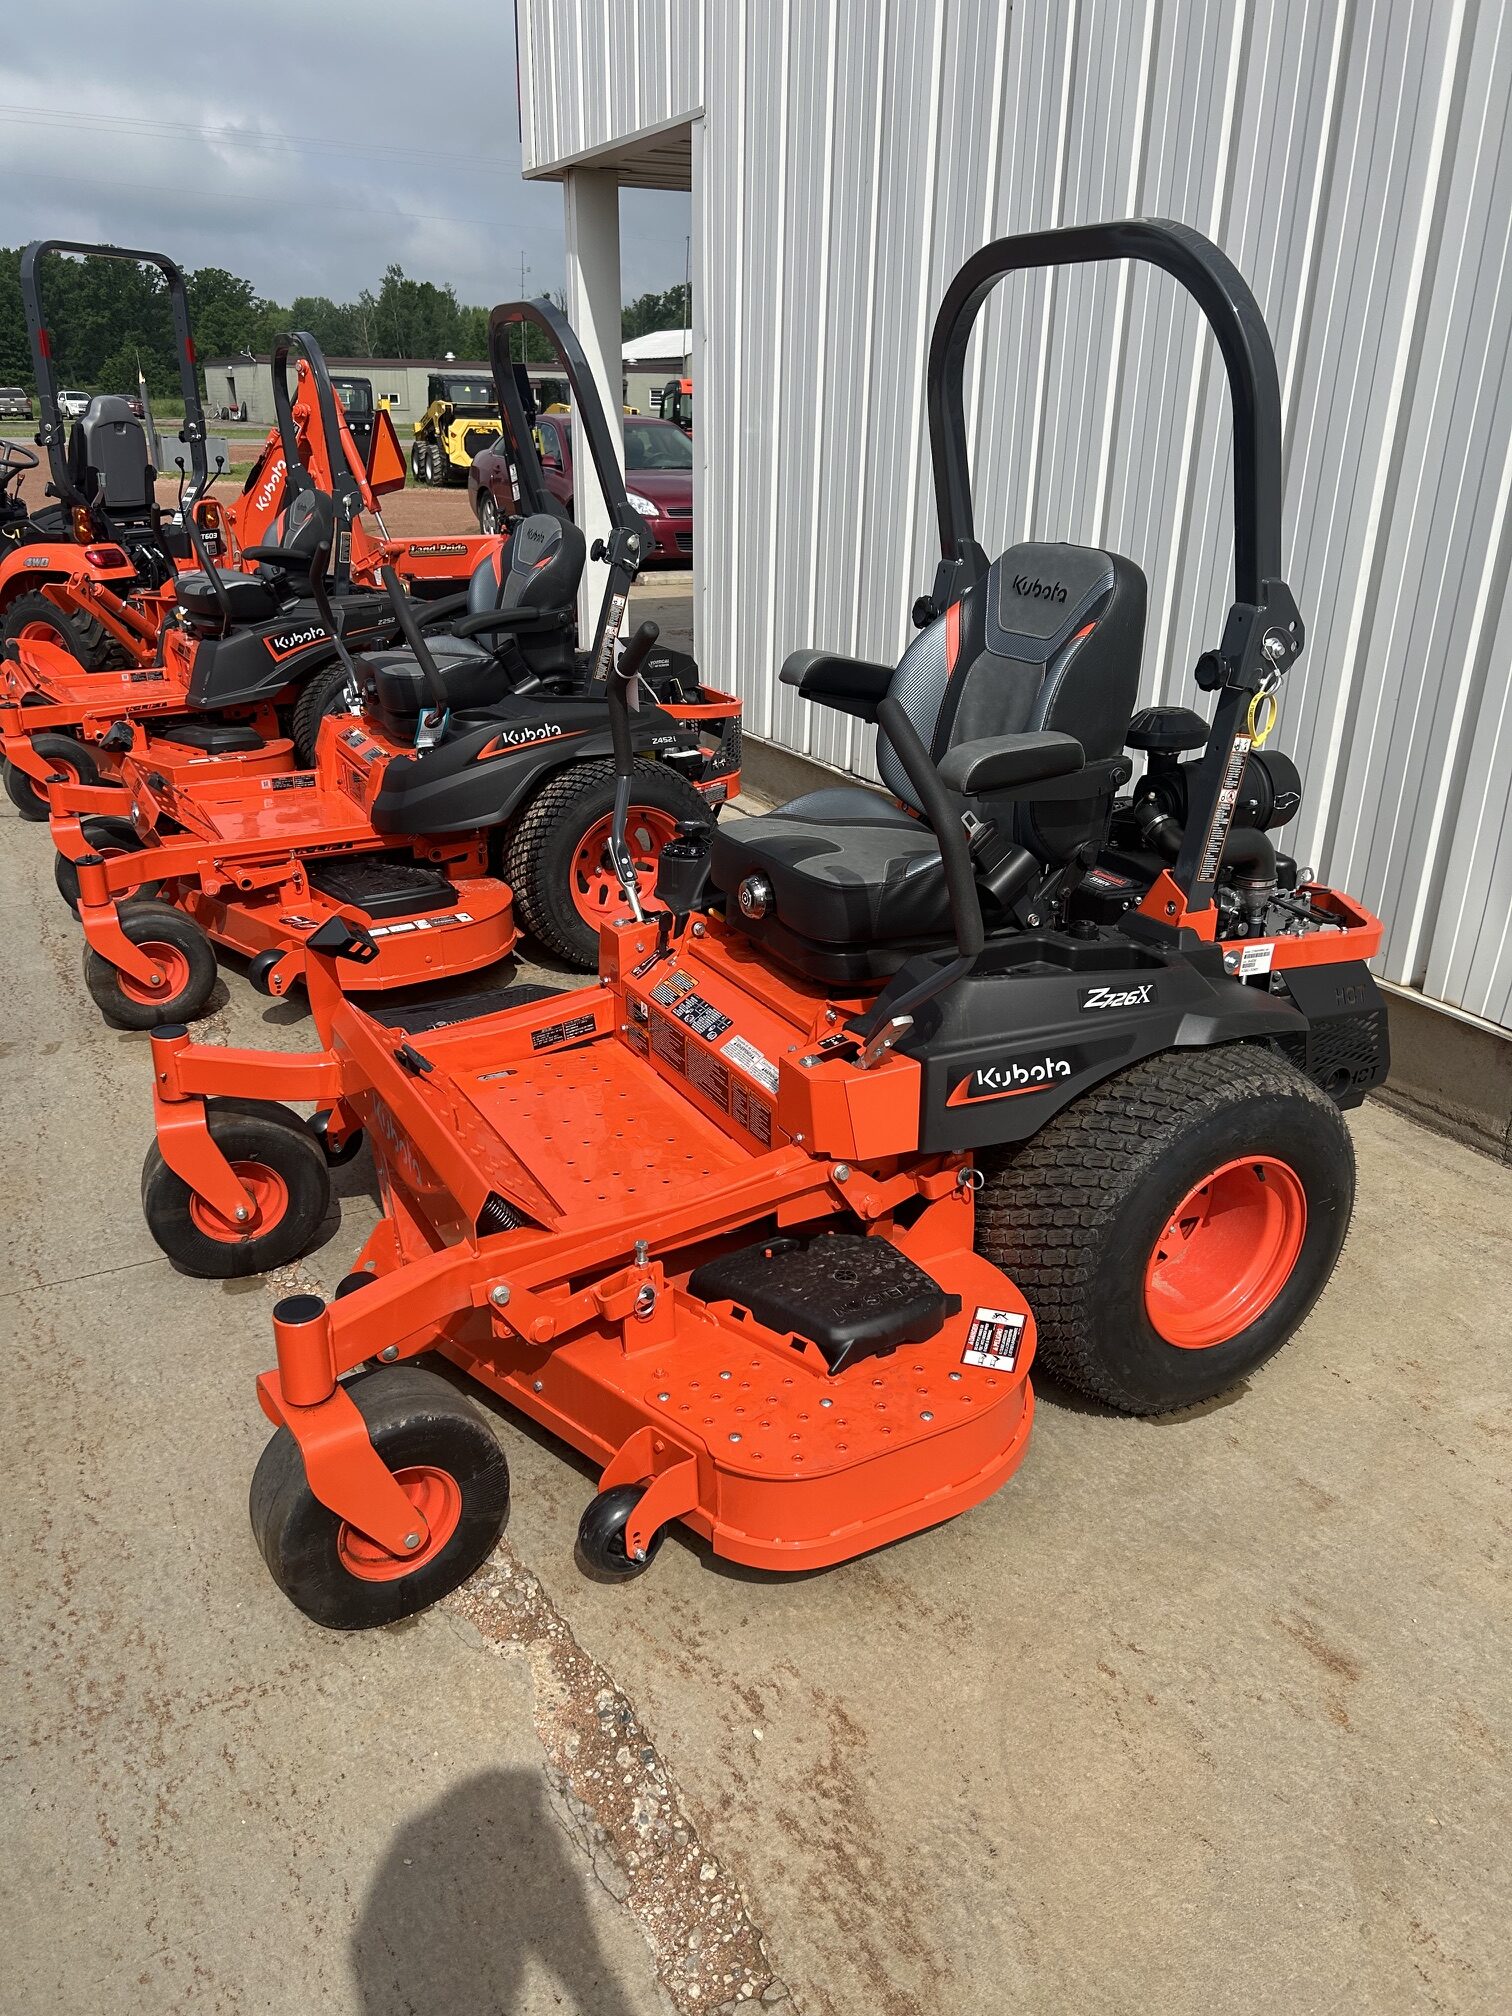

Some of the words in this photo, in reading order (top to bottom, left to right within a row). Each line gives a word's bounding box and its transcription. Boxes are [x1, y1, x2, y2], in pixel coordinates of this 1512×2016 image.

[255, 460, 287, 511] Kubota
[1012, 574, 1068, 604] Kubota
[274, 627, 326, 649] Kubota
[502, 723, 562, 745] Kubota
[1083, 984, 1154, 1009] Z726X
[976, 1057, 1071, 1088] Kubota
